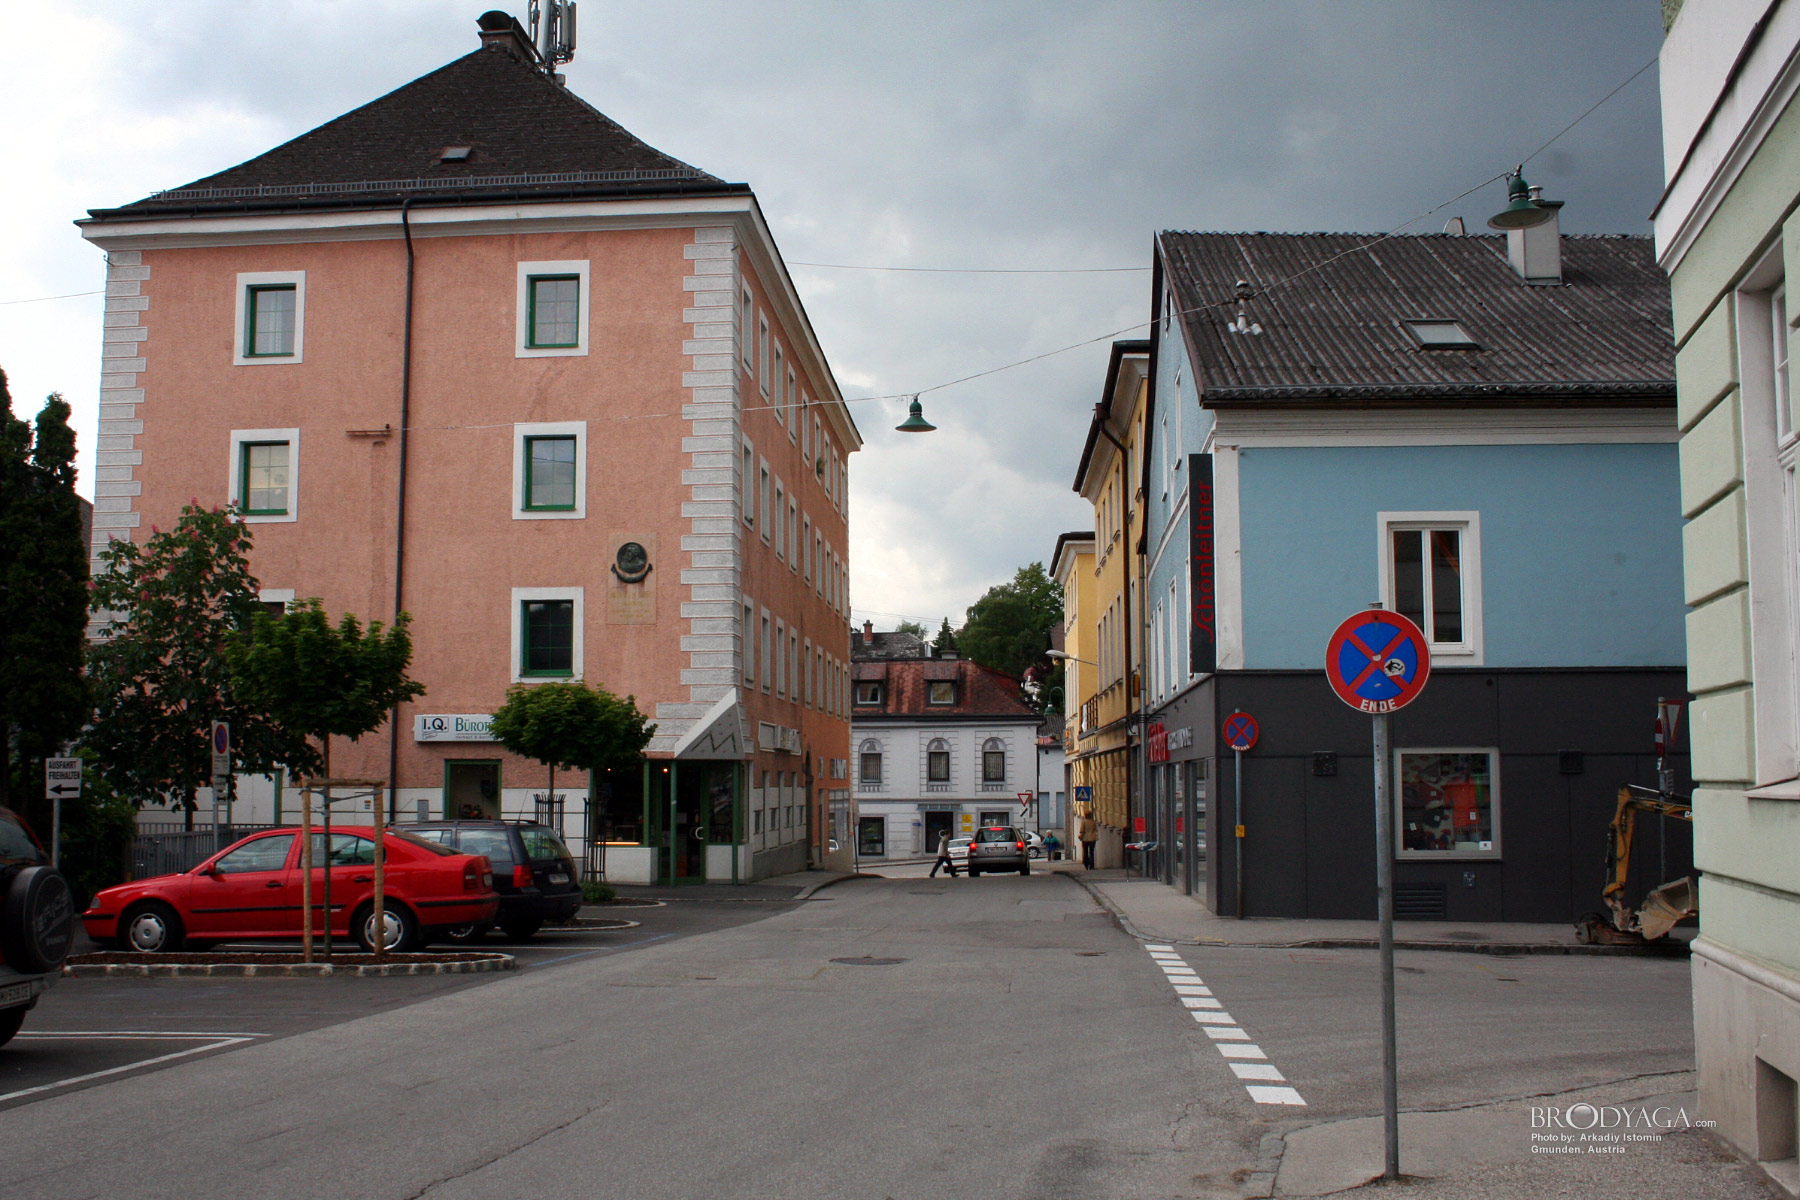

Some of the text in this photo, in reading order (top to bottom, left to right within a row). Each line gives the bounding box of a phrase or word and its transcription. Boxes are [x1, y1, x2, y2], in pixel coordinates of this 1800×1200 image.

[1192, 480, 1215, 644] Schönleitner
[1360, 698, 1398, 712] ENDE
[423, 717, 448, 731] I.Q.
[48, 760, 77, 769] AUSFAHRT
[48, 771, 81, 780] FREIHALTEN
